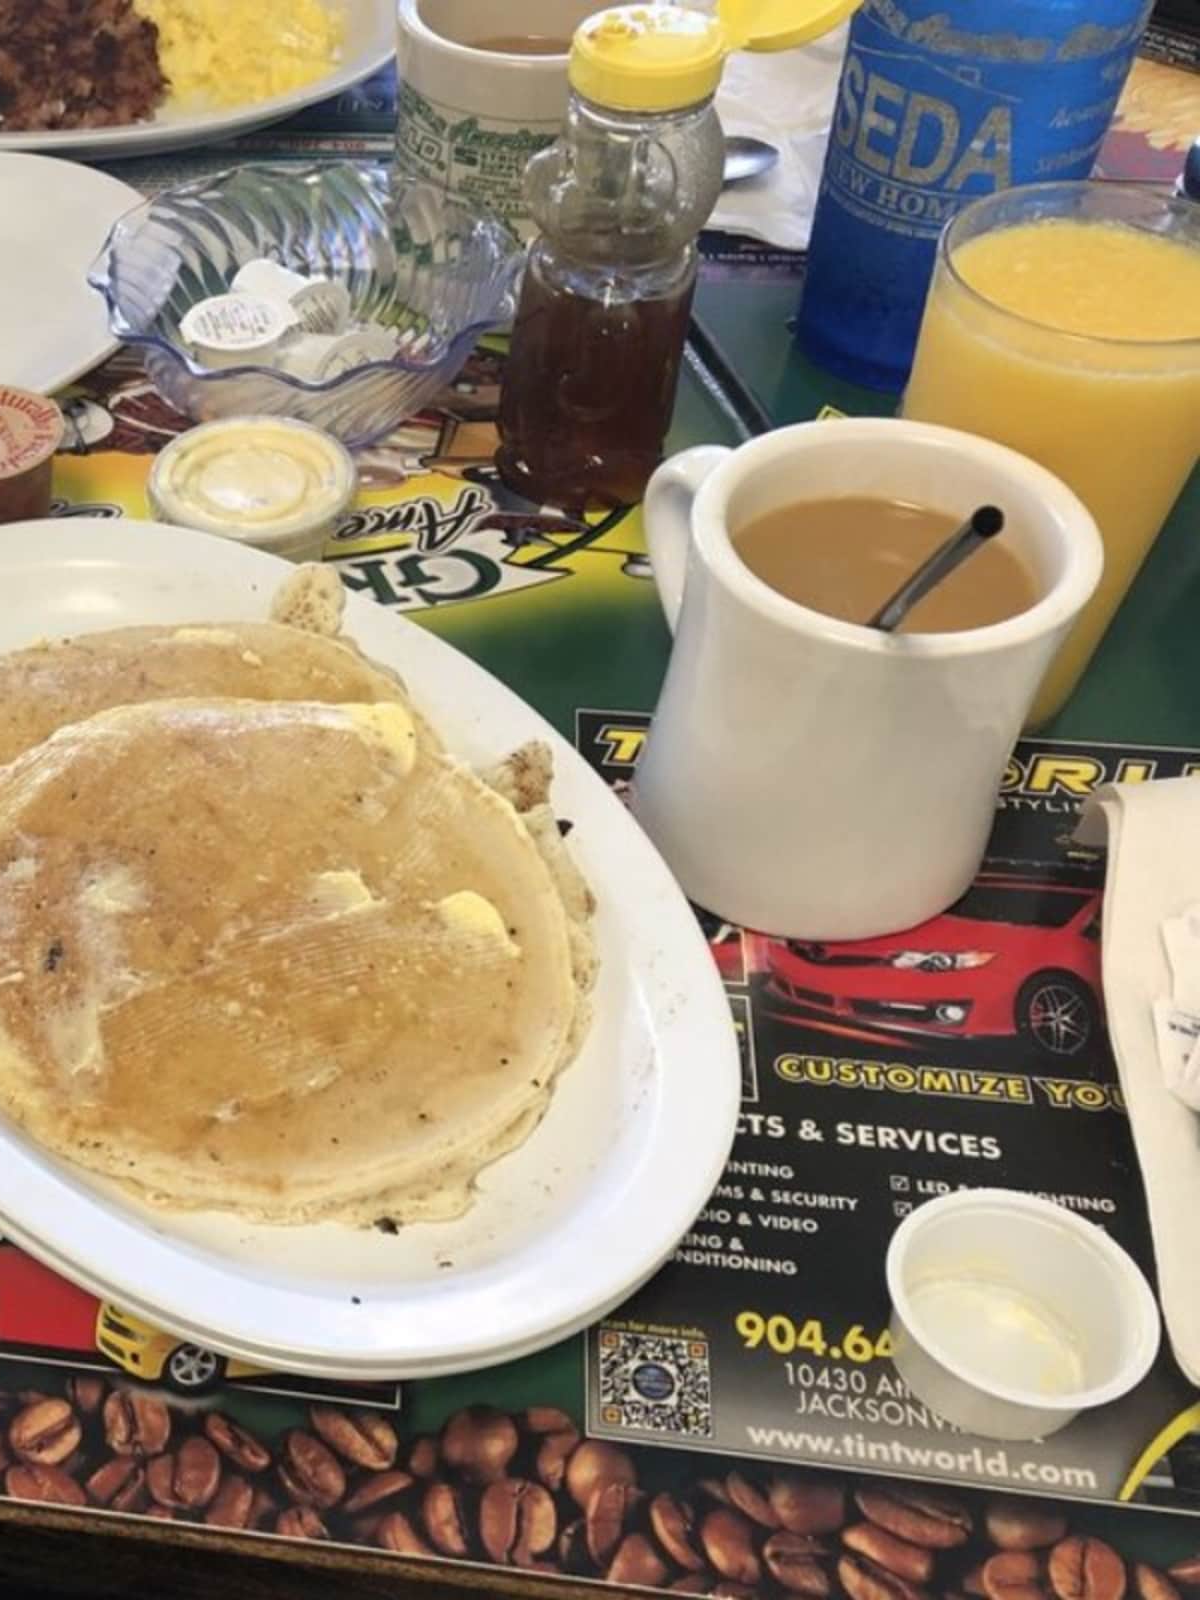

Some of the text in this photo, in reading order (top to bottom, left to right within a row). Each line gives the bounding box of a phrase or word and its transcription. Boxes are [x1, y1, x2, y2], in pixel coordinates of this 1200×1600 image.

[835, 53, 1011, 196] SEDA
[776, 1054, 1034, 1104] CUSTOMIZE
[798, 1119, 823, 1142] &
[836, 1122, 1002, 1160] SERVICES
[750, 1187, 765, 1201] &
[771, 1189, 859, 1212] SECURITY
[916, 1179, 950, 1195] LED
[737, 1211, 752, 1227] &
[758, 1213, 819, 1234] VIDEO
[729, 1236, 744, 1251] &
[784, 1361, 867, 1394] 10430
[746, 1426, 1098, 1489] www.tintworld.com
